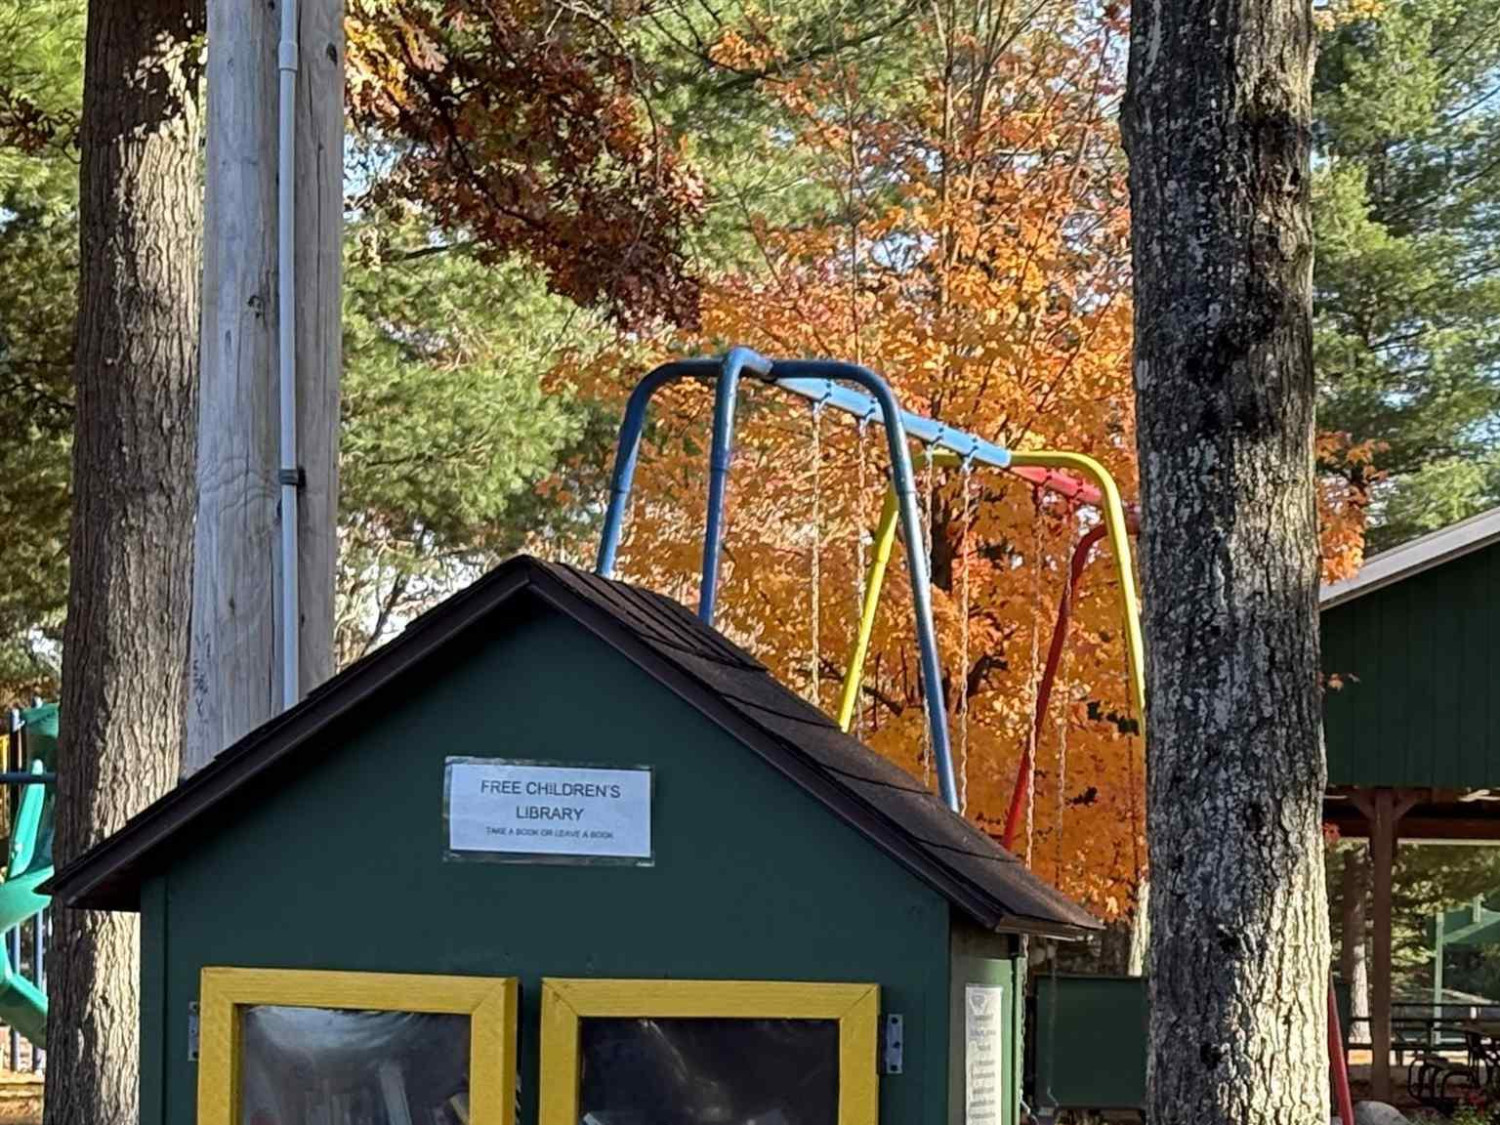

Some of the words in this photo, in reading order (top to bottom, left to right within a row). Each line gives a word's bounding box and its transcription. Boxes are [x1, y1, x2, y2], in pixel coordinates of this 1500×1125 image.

[480, 780, 522, 795] FREE
[526, 781, 622, 799] CHILDREN'S
[516, 806, 585, 821] LIBRARY
[486, 826, 506, 836] TAKE
[508, 828, 514, 836] A
[516, 828, 538, 837] BOOK
[541, 829, 553, 837] OR
[555, 829, 580, 838] LEAVE
[582, 831, 588, 839] A
[590, 831, 614, 839] BOOK
